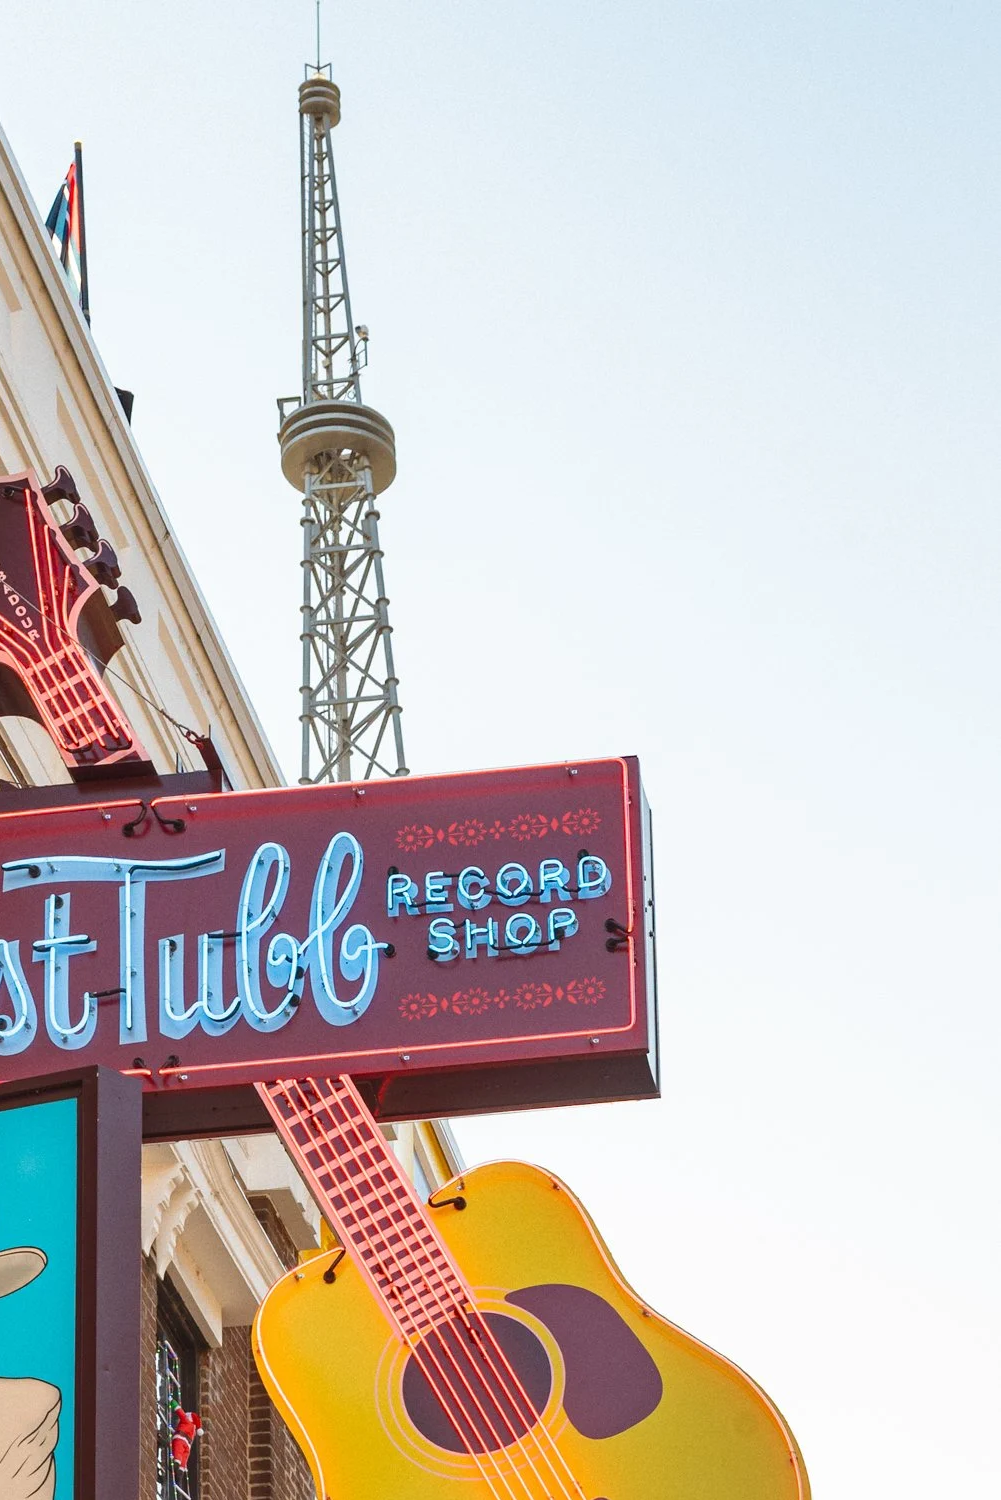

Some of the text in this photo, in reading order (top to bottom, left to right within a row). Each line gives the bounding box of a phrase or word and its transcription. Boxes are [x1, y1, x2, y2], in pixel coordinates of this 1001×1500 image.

[387, 855, 612, 917] RECORD
[1, 830, 388, 1046] Tubb
[428, 908, 579, 962] SHOP
